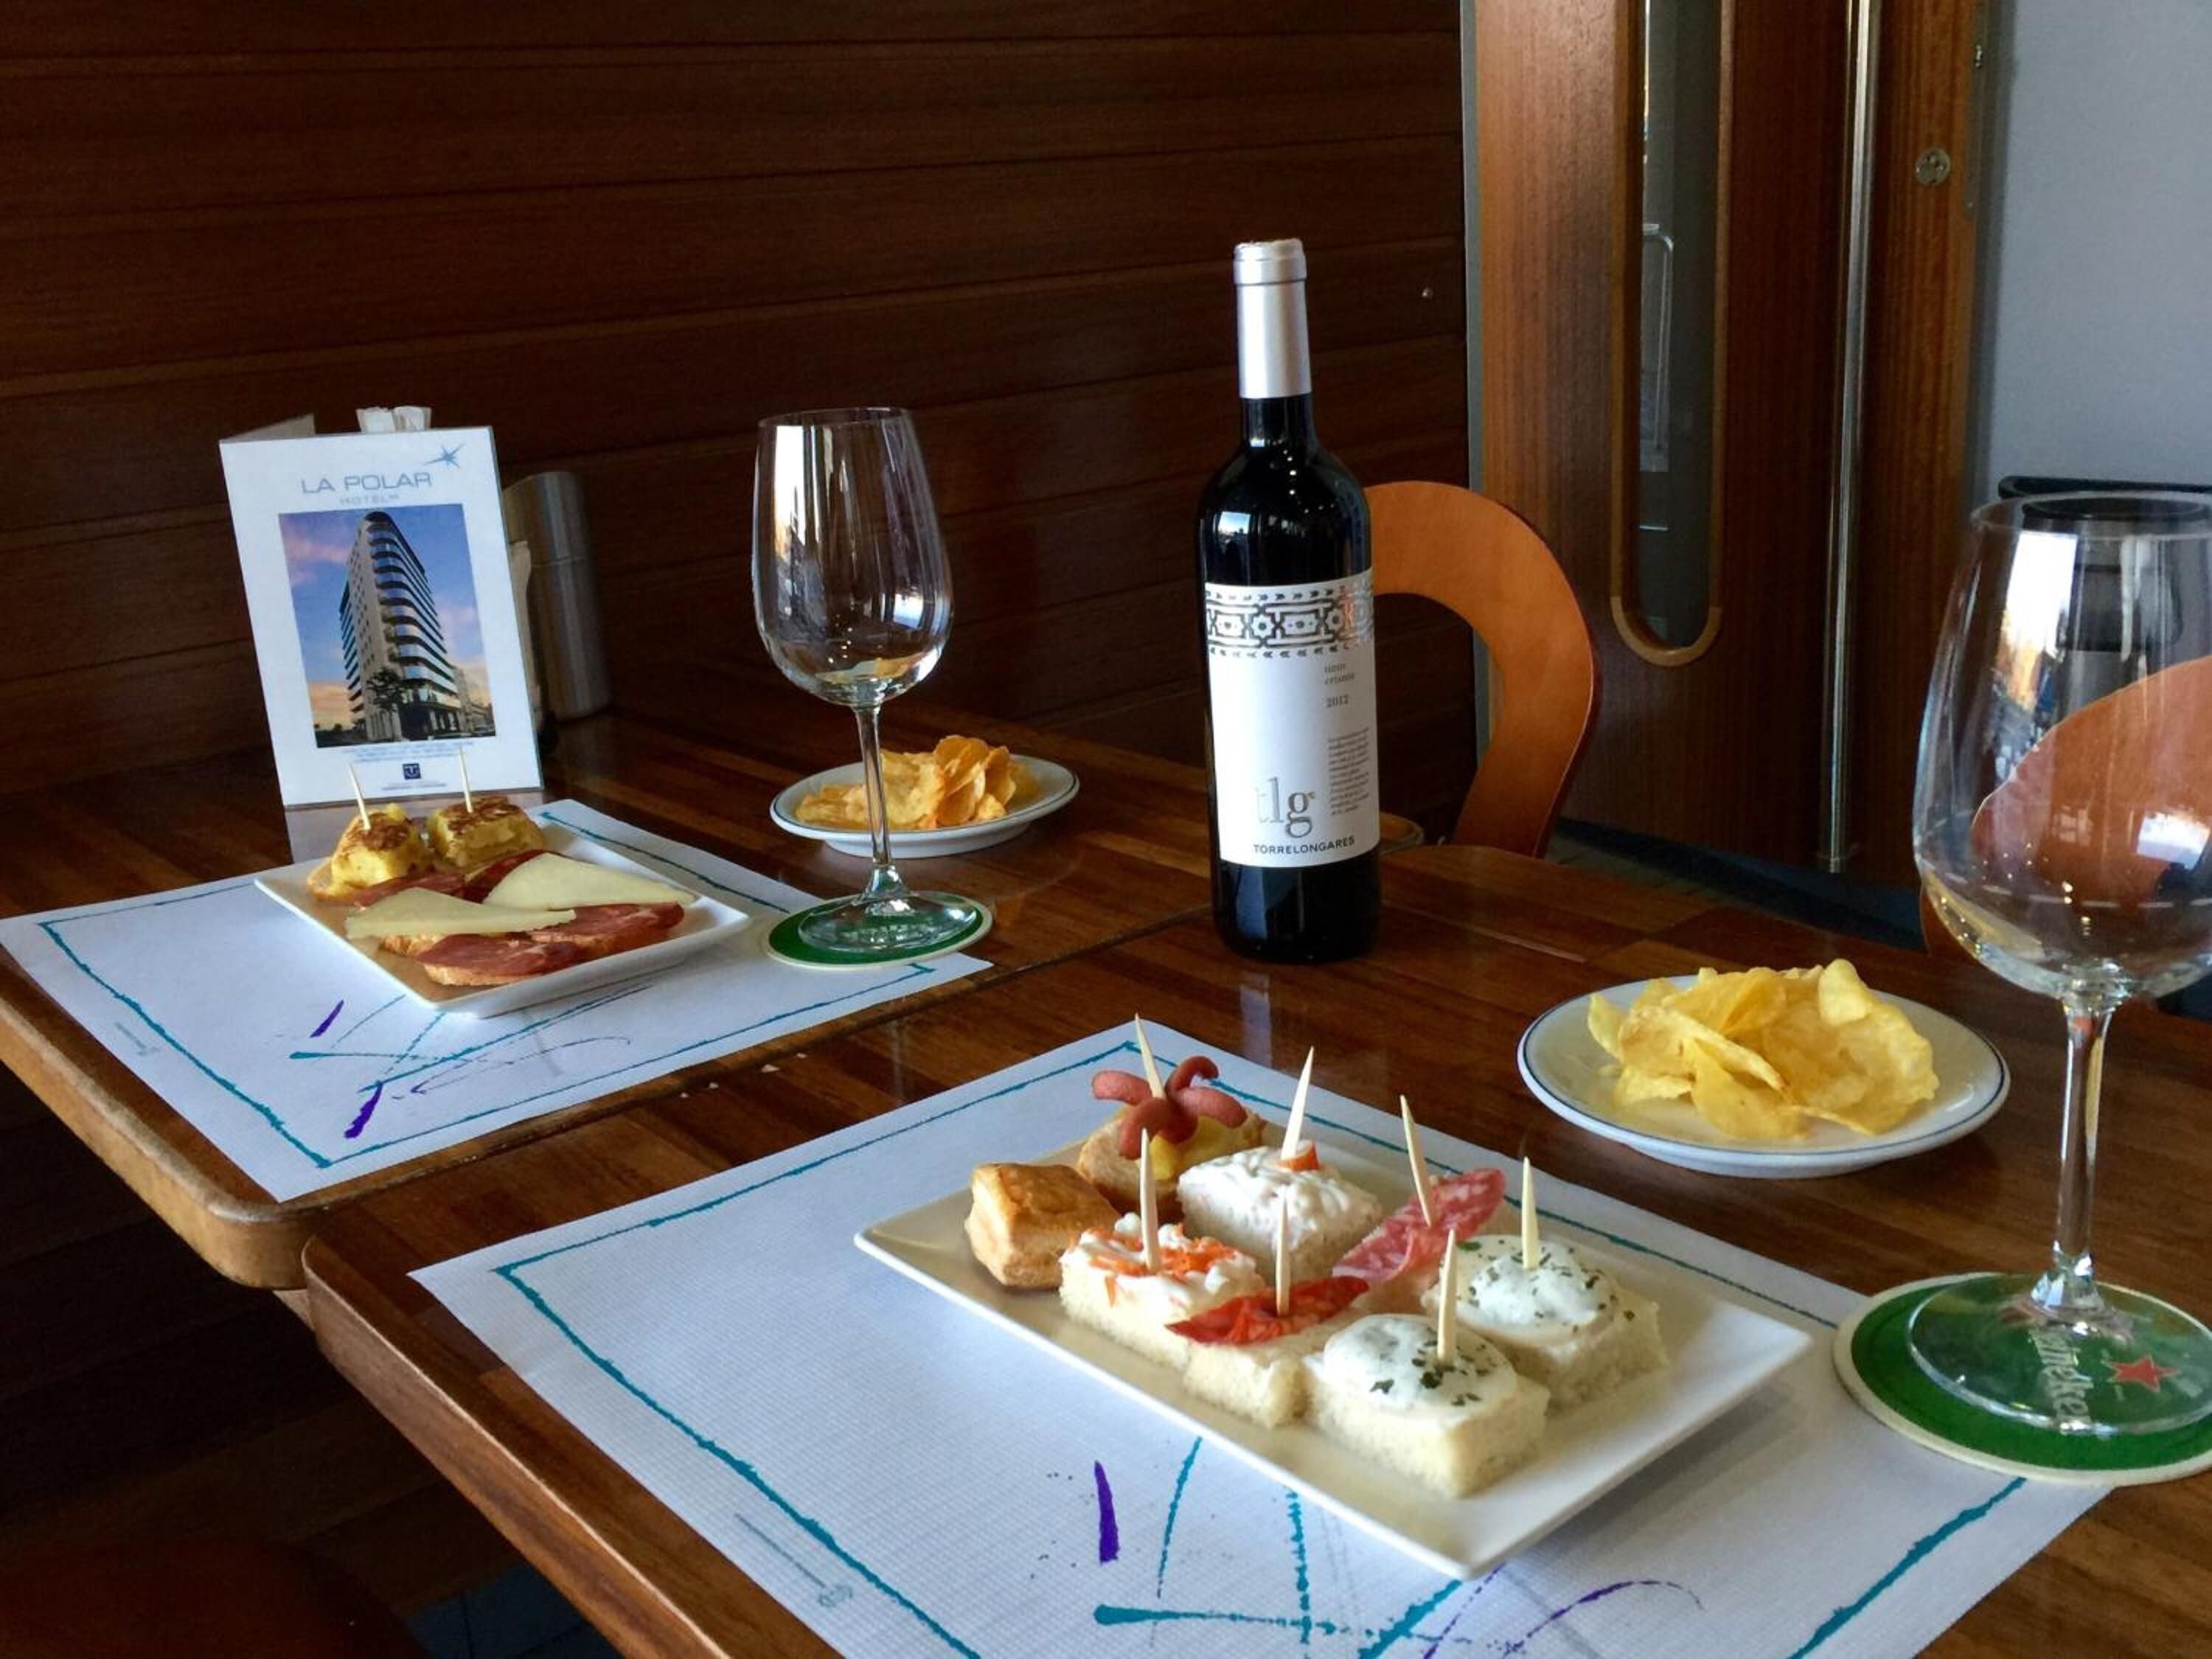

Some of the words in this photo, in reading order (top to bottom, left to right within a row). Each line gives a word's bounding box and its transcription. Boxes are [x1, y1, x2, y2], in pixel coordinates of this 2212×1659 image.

[301, 478, 335, 493] LA
[344, 472, 432, 490] POLAR
[1253, 835, 1355, 854] TORRELONGARES
